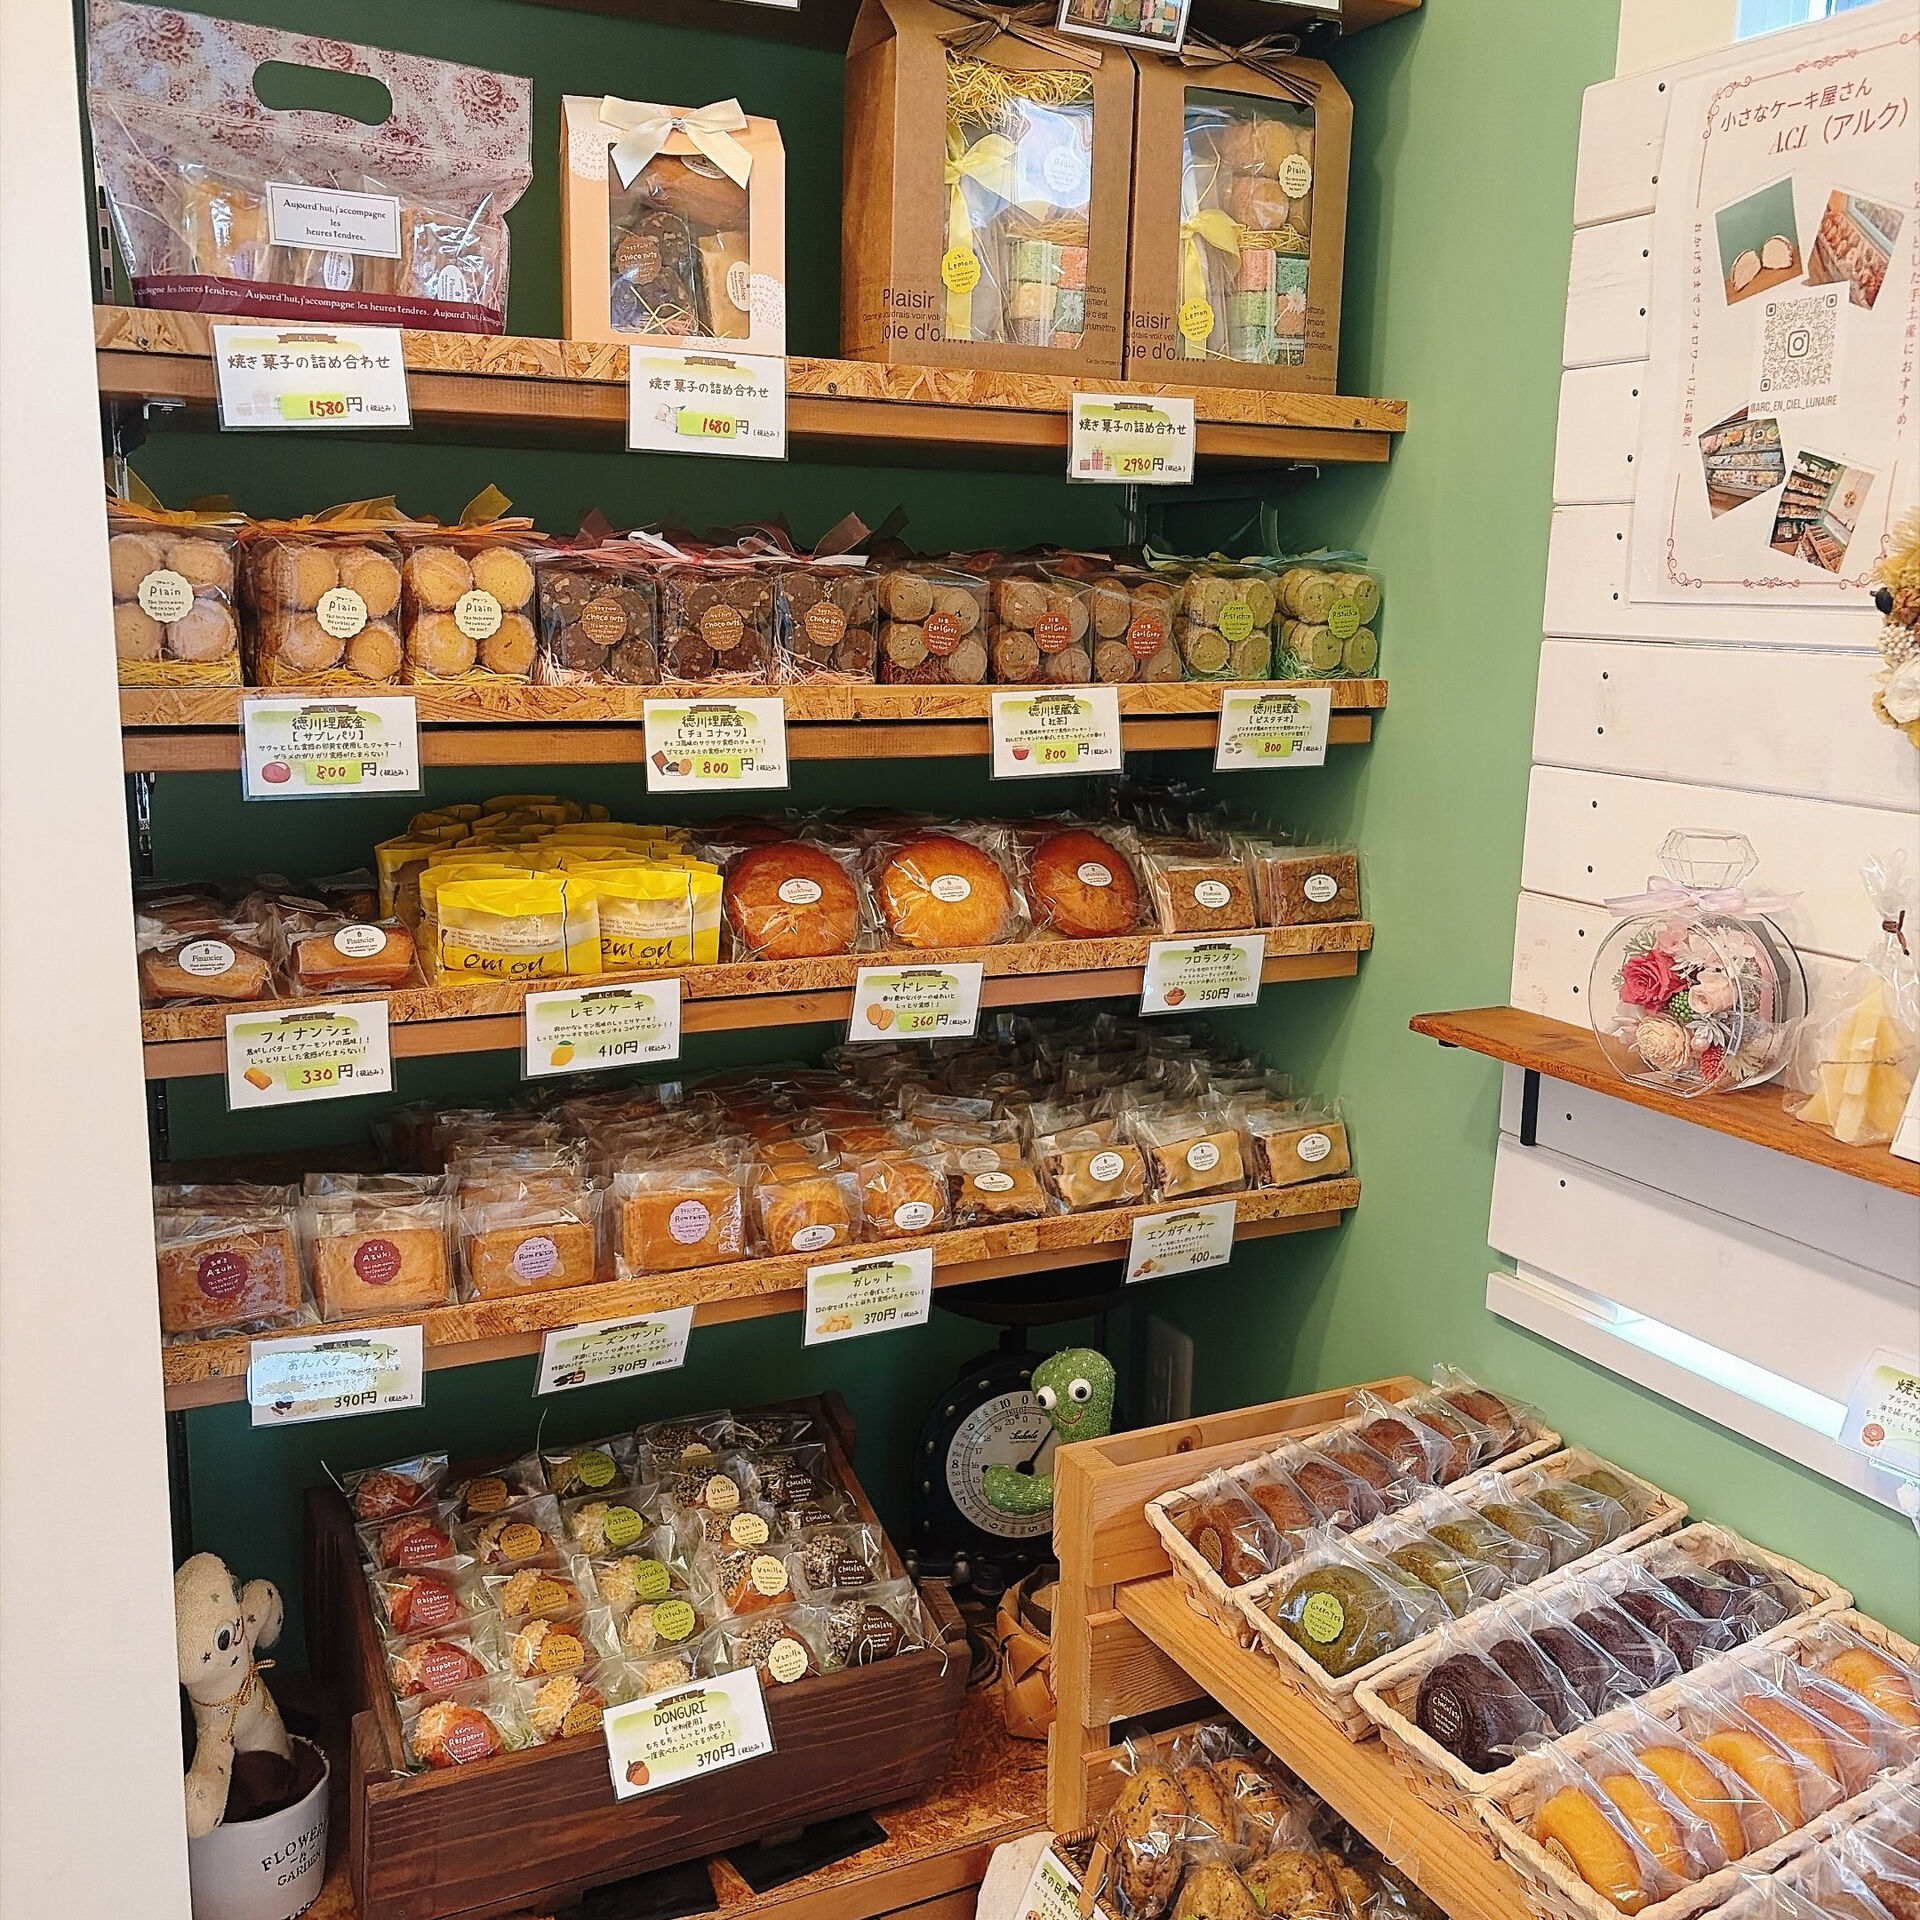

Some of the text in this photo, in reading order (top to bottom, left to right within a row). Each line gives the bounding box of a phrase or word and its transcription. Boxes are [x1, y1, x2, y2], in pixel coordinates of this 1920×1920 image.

[1720, 77, 1872, 132] 小さなケーキ屋さん
[1286, 165, 1306, 175] Plain
[283, 198, 387, 221] Aujourd'hui, j'accompagne
[330, 218, 341, 228] les
[305, 227, 335, 239] heures
[619, 251, 642, 262] Choco
[948, 260, 973, 271] Lemon
[245, 289, 301, 305] Aujourd'hui,
[300, 293, 355, 310] j'accompagne
[356, 301, 368, 310] les
[369, 303, 397, 314] heures
[882, 289, 935, 308] Plaisir
[1184, 310, 1208, 321] Lemon
[881, 322, 908, 344] joie
[227, 353, 391, 370] 焼き菓子の詰め合わせ
[648, 378, 769, 398] 焼き菓子の詰め合わせ
[1079, 418, 1187, 435] 焼き菓子の詰め合わせ
[150, 586, 181, 597] Plain
[329, 601, 357, 611] Plain
[466, 603, 492, 613] Plain
[586, 613, 624, 623] Choco nuts
[704, 619, 741, 630] Choco nuts
[809, 615, 843, 627] Choco nuts
[928, 624, 943, 633] Earl
[1040, 624, 1053, 632] Earl
[1028, 703, 1081, 717] 徳川埋蔵金
[1252, 703, 1301, 714] 徳川埋蔵金
[291, 716, 367, 730] 徳川埋蔵金
[682, 715, 744, 728] 徳川埋蔵金
[346, 937, 375, 945] Financier
[1185, 953, 1239, 965] フロランタン
[891, 980, 950, 993] マドレーヌ
[1200, 987, 1230, 1000] 350円
[570, 1001, 644, 1019] レモンケーキ
[260, 1026, 352, 1044] フィナンシェ
[598, 1040, 638, 1058] 410円
[1147, 1221, 1215, 1240] エンガディナー
[362, 1251, 391, 1262] Azuki
[206, 1264, 237, 1278] Azuki
[853, 1273, 893, 1287] ガレット
[864, 1308, 896, 1324] 370円
[582, 1327, 665, 1350] レーズンサンド
[287, 1349, 399, 1371] あんバターサンド
[609, 1359, 646, 1375] 390円
[334, 1391, 377, 1408] 390円
[1000, 1398, 1010, 1409] 10
[1022, 1395, 1029, 1405] 0
[1005, 1418, 1015, 1426] 20
[952, 1459, 959, 1469] 8
[786, 1477, 812, 1488] Chocolate
[711, 1484, 734, 1495] Vanilla
[805, 1513, 831, 1523] Chocolate
[735, 1518, 763, 1532] Vanilla
[404, 1542, 438, 1553] Raspberry
[637, 1568, 664, 1582] Pistachio
[757, 1566, 783, 1575] Vanilla
[838, 1563, 867, 1574] Chocolate
[416, 1593, 450, 1605] Raspberry
[657, 1607, 689, 1621] Pistachio
[1310, 1601, 1328, 1617] Green
[863, 1620, 893, 1631] Chocolate
[774, 1650, 801, 1663] Vanilla
[426, 1658, 462, 1674] Raspberry
[654, 1700, 708, 1727] DONGURI
[449, 1730, 484, 1747] Raspberry
[696, 1742, 736, 1767] 370円
[278, 1849, 321, 1887] GARDEN
